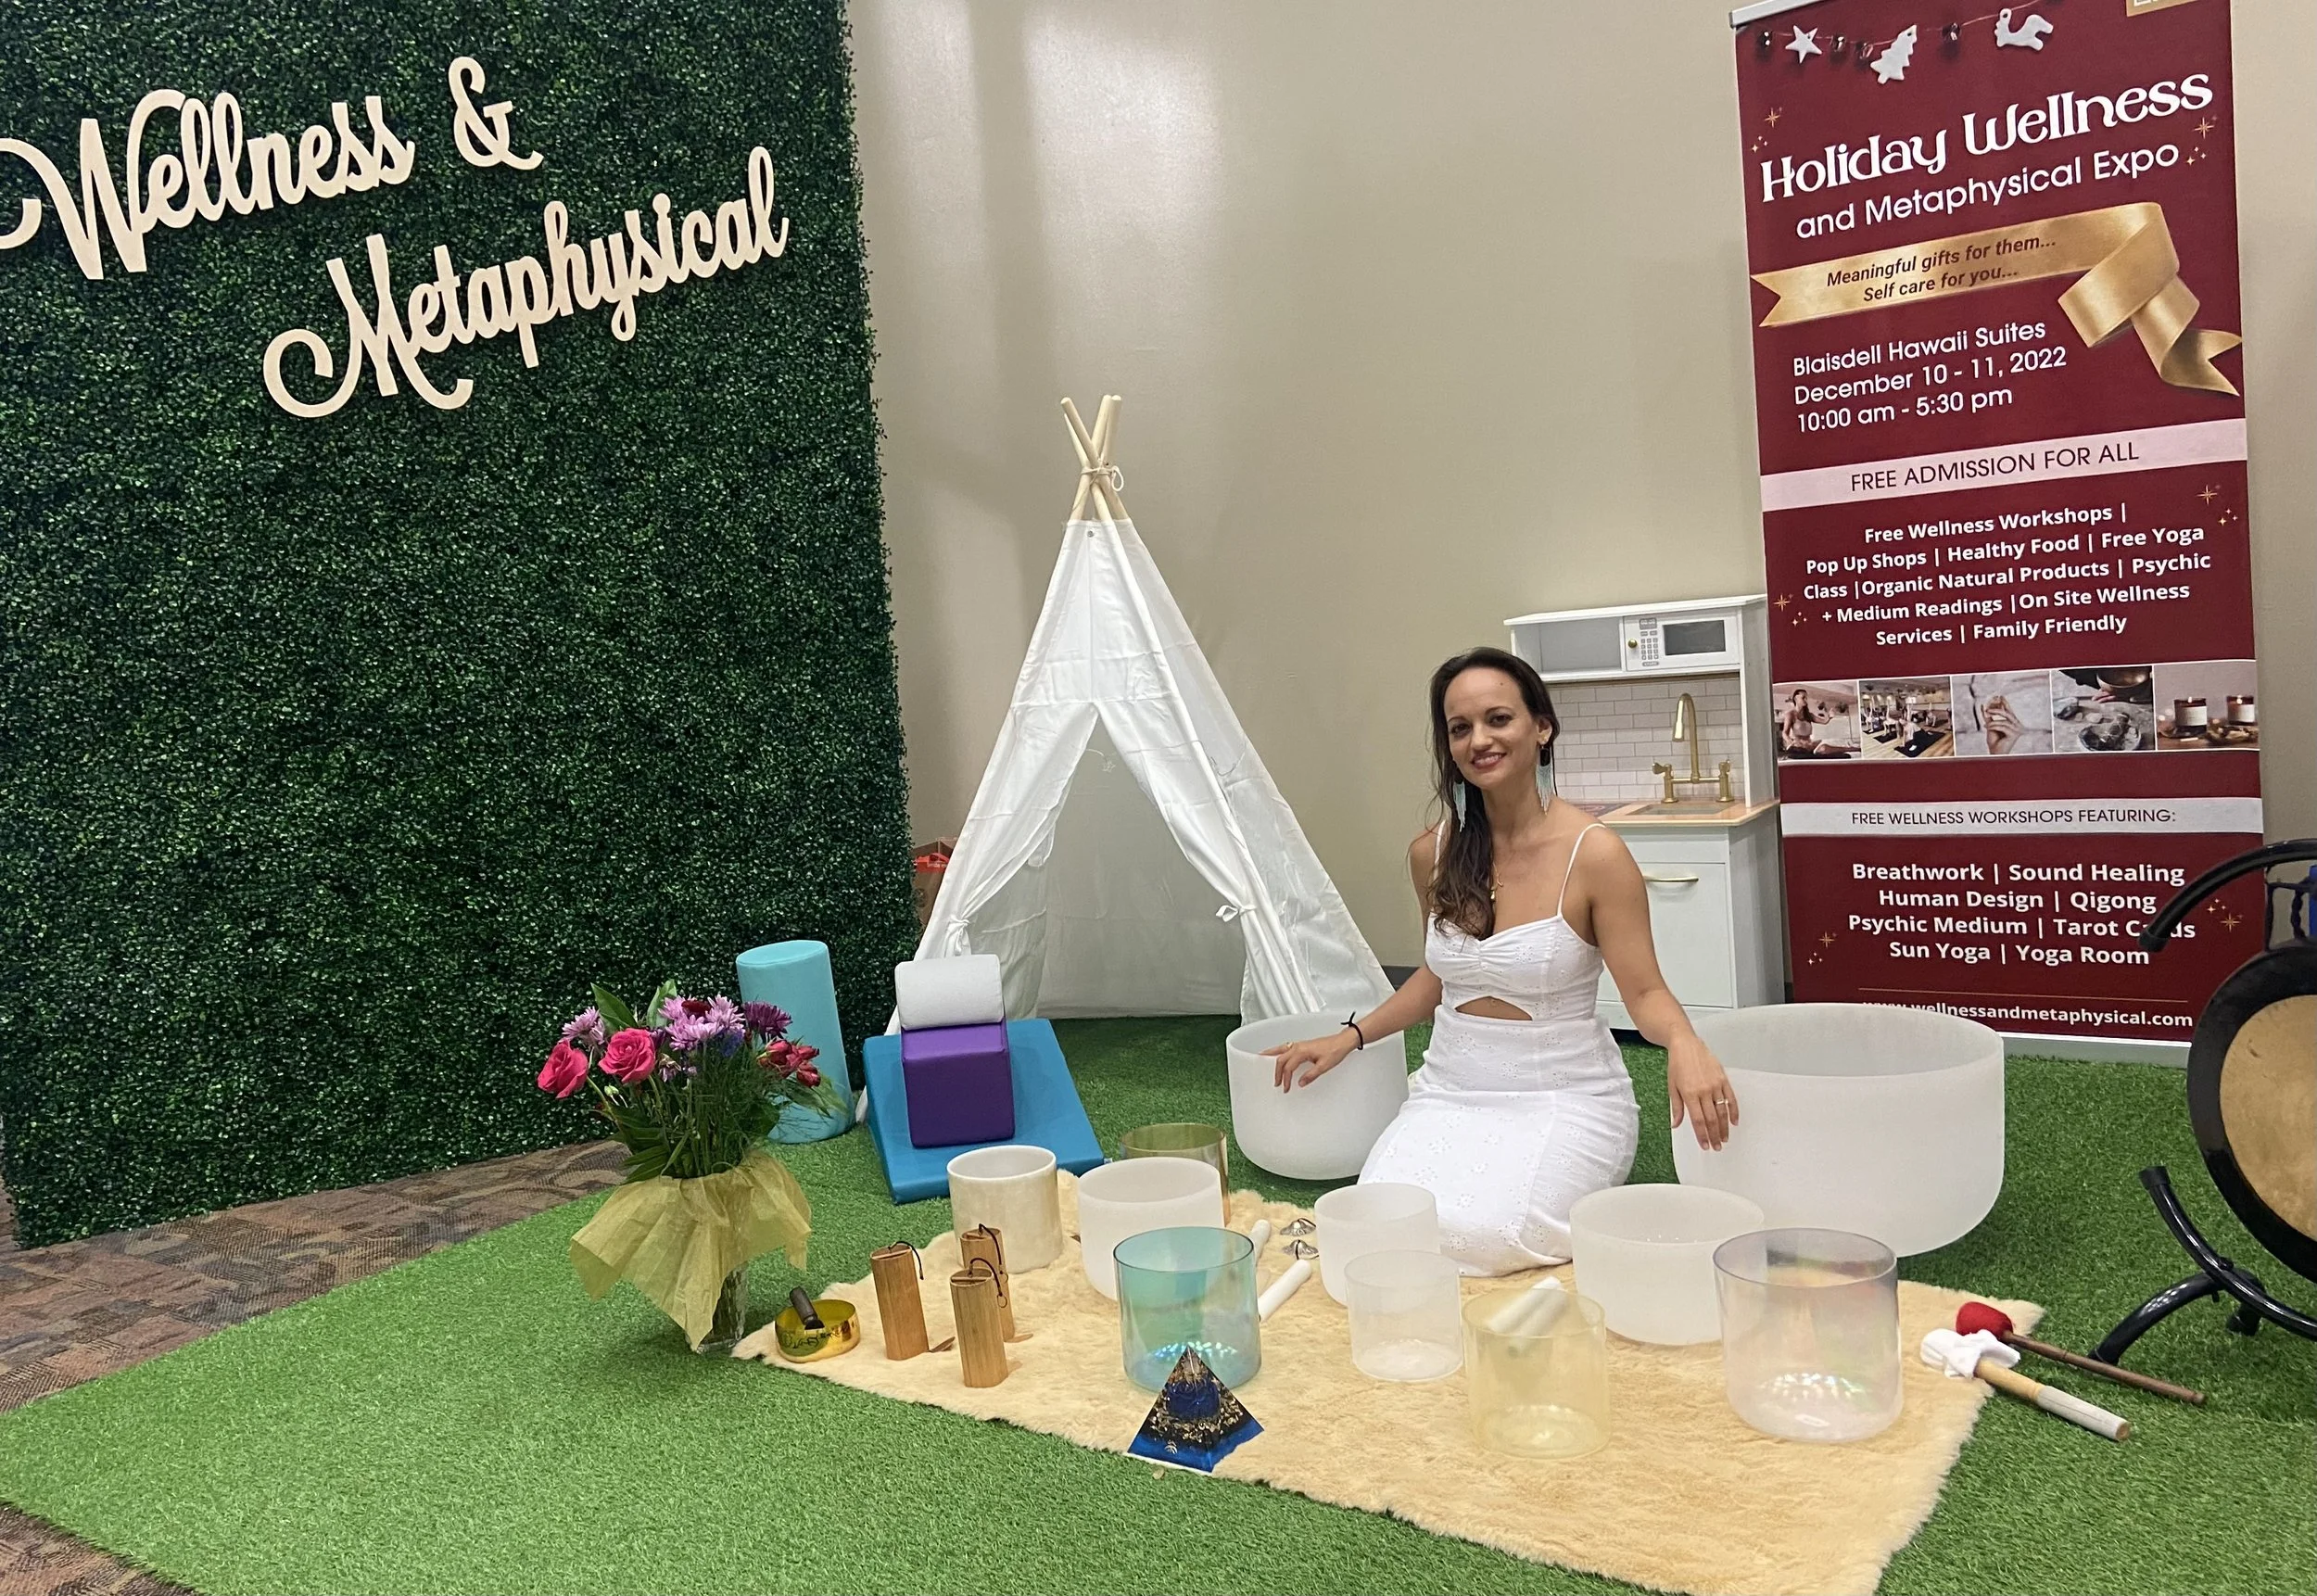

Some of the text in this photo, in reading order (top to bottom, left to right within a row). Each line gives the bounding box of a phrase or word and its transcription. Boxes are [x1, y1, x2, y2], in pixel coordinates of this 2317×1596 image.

[1761, 74, 2213, 202] Holiday Wellness
[0, 57, 544, 280] Wellness &
[1797, 145, 2179, 238] and Metaphysical Expo
[263, 146, 790, 418] Metaphysical
[1828, 237, 2056, 286] Meaningful gifts for them...
[1864, 267, 2019, 301] Self care for you...
[1793, 323, 2045, 376] Blaisdell Hawaii Suites
[1795, 373, 1913, 404] December
[1922, 364, 1947, 386] 10
[1971, 357, 2003, 378] 11,
[2010, 346, 2067, 373] 2022
[1798, 408, 1851, 432] 10:00
[1857, 406, 1894, 424] am
[1917, 391, 1963, 416] 5:30
[1971, 389, 2012, 413] pm
[1852, 442, 2139, 491] FREE ADMISSION FOR ALL
[1866, 528, 1904, 543] Free
[1907, 519, 1994, 538] Wellness
[1998, 508, 2112, 529] Workshops
[1806, 560, 1838, 576] Pop
[1843, 556, 1868, 574] Up
[1872, 553, 1927, 570] Shops
[1948, 541, 2025, 562] Healthy
[2032, 534, 2079, 554] Food
[2102, 533, 2146, 548] Free
[2152, 528, 2204, 546] Yoga
[1804, 584, 1847, 599] Class
[1939, 567, 2013, 589] Natural
[2020, 563, 2109, 582] Products
[2133, 552, 2210, 576] Psychic
[1837, 605, 1909, 622] Medium
[1916, 599, 2002, 617] Readings
[2054, 590, 2092, 606] Site
[2096, 586, 2190, 603] Wellness
[1876, 628, 1952, 645] Services
[1974, 620, 2039, 640] Family
[2045, 614, 2127, 634] Friendly
[1852, 809, 2175, 825] FREE WELLNESS WORKSHOPS FEATURING:
[1853, 864, 1984, 880] Breathwork
[2009, 864, 2083, 880] Sound
[2091, 864, 2184, 886] Healing
[1880, 890, 1958, 906] Human
[1967, 891, 2043, 912] Design
[2070, 892, 2157, 914] Qigong
[1849, 915, 1928, 935] Psychic
[1934, 917, 2027, 934] Medium
[2053, 918, 2119, 936] Tarot
[2126, 920, 2196, 938] Cds
[1890, 942, 1930, 957] Sun
[1935, 944, 1990, 964] Yoga
[2016, 945, 2072, 966] Yoga
[2081, 946, 2149, 964] Room
